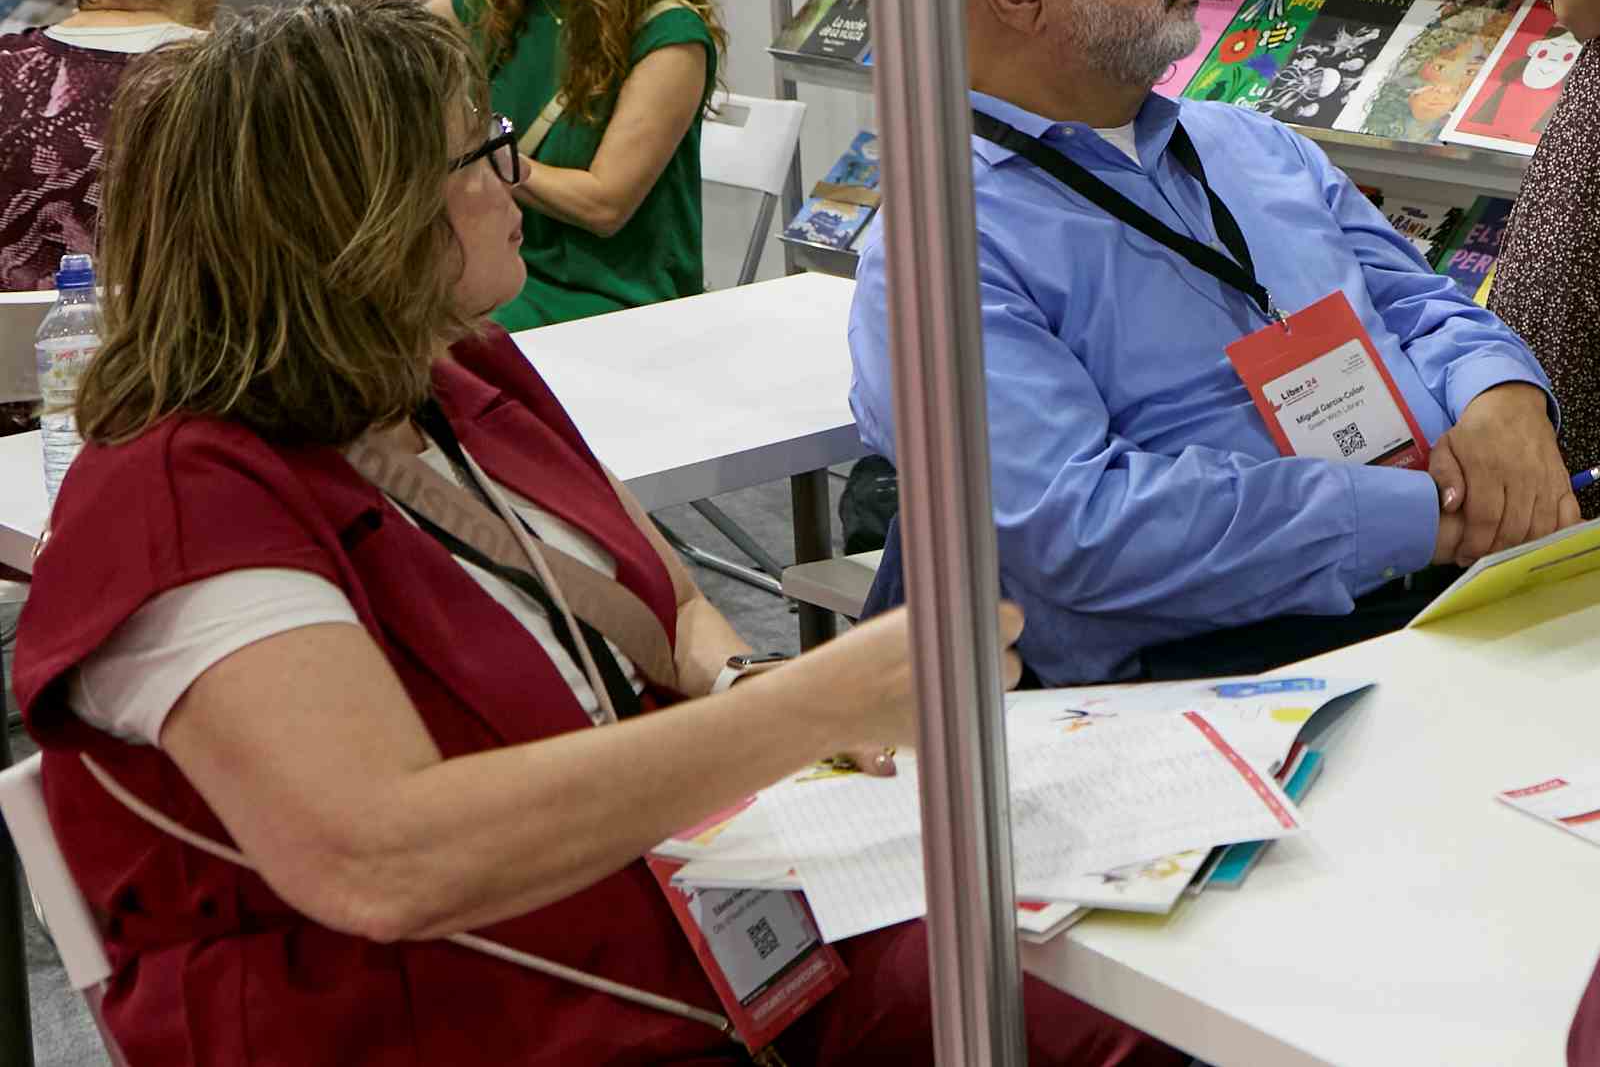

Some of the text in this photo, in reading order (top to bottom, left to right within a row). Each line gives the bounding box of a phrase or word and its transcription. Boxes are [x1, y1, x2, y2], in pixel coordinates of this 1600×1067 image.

[1446, 249, 1496, 274] PER
[1280, 376, 1318, 401] Liber 24
